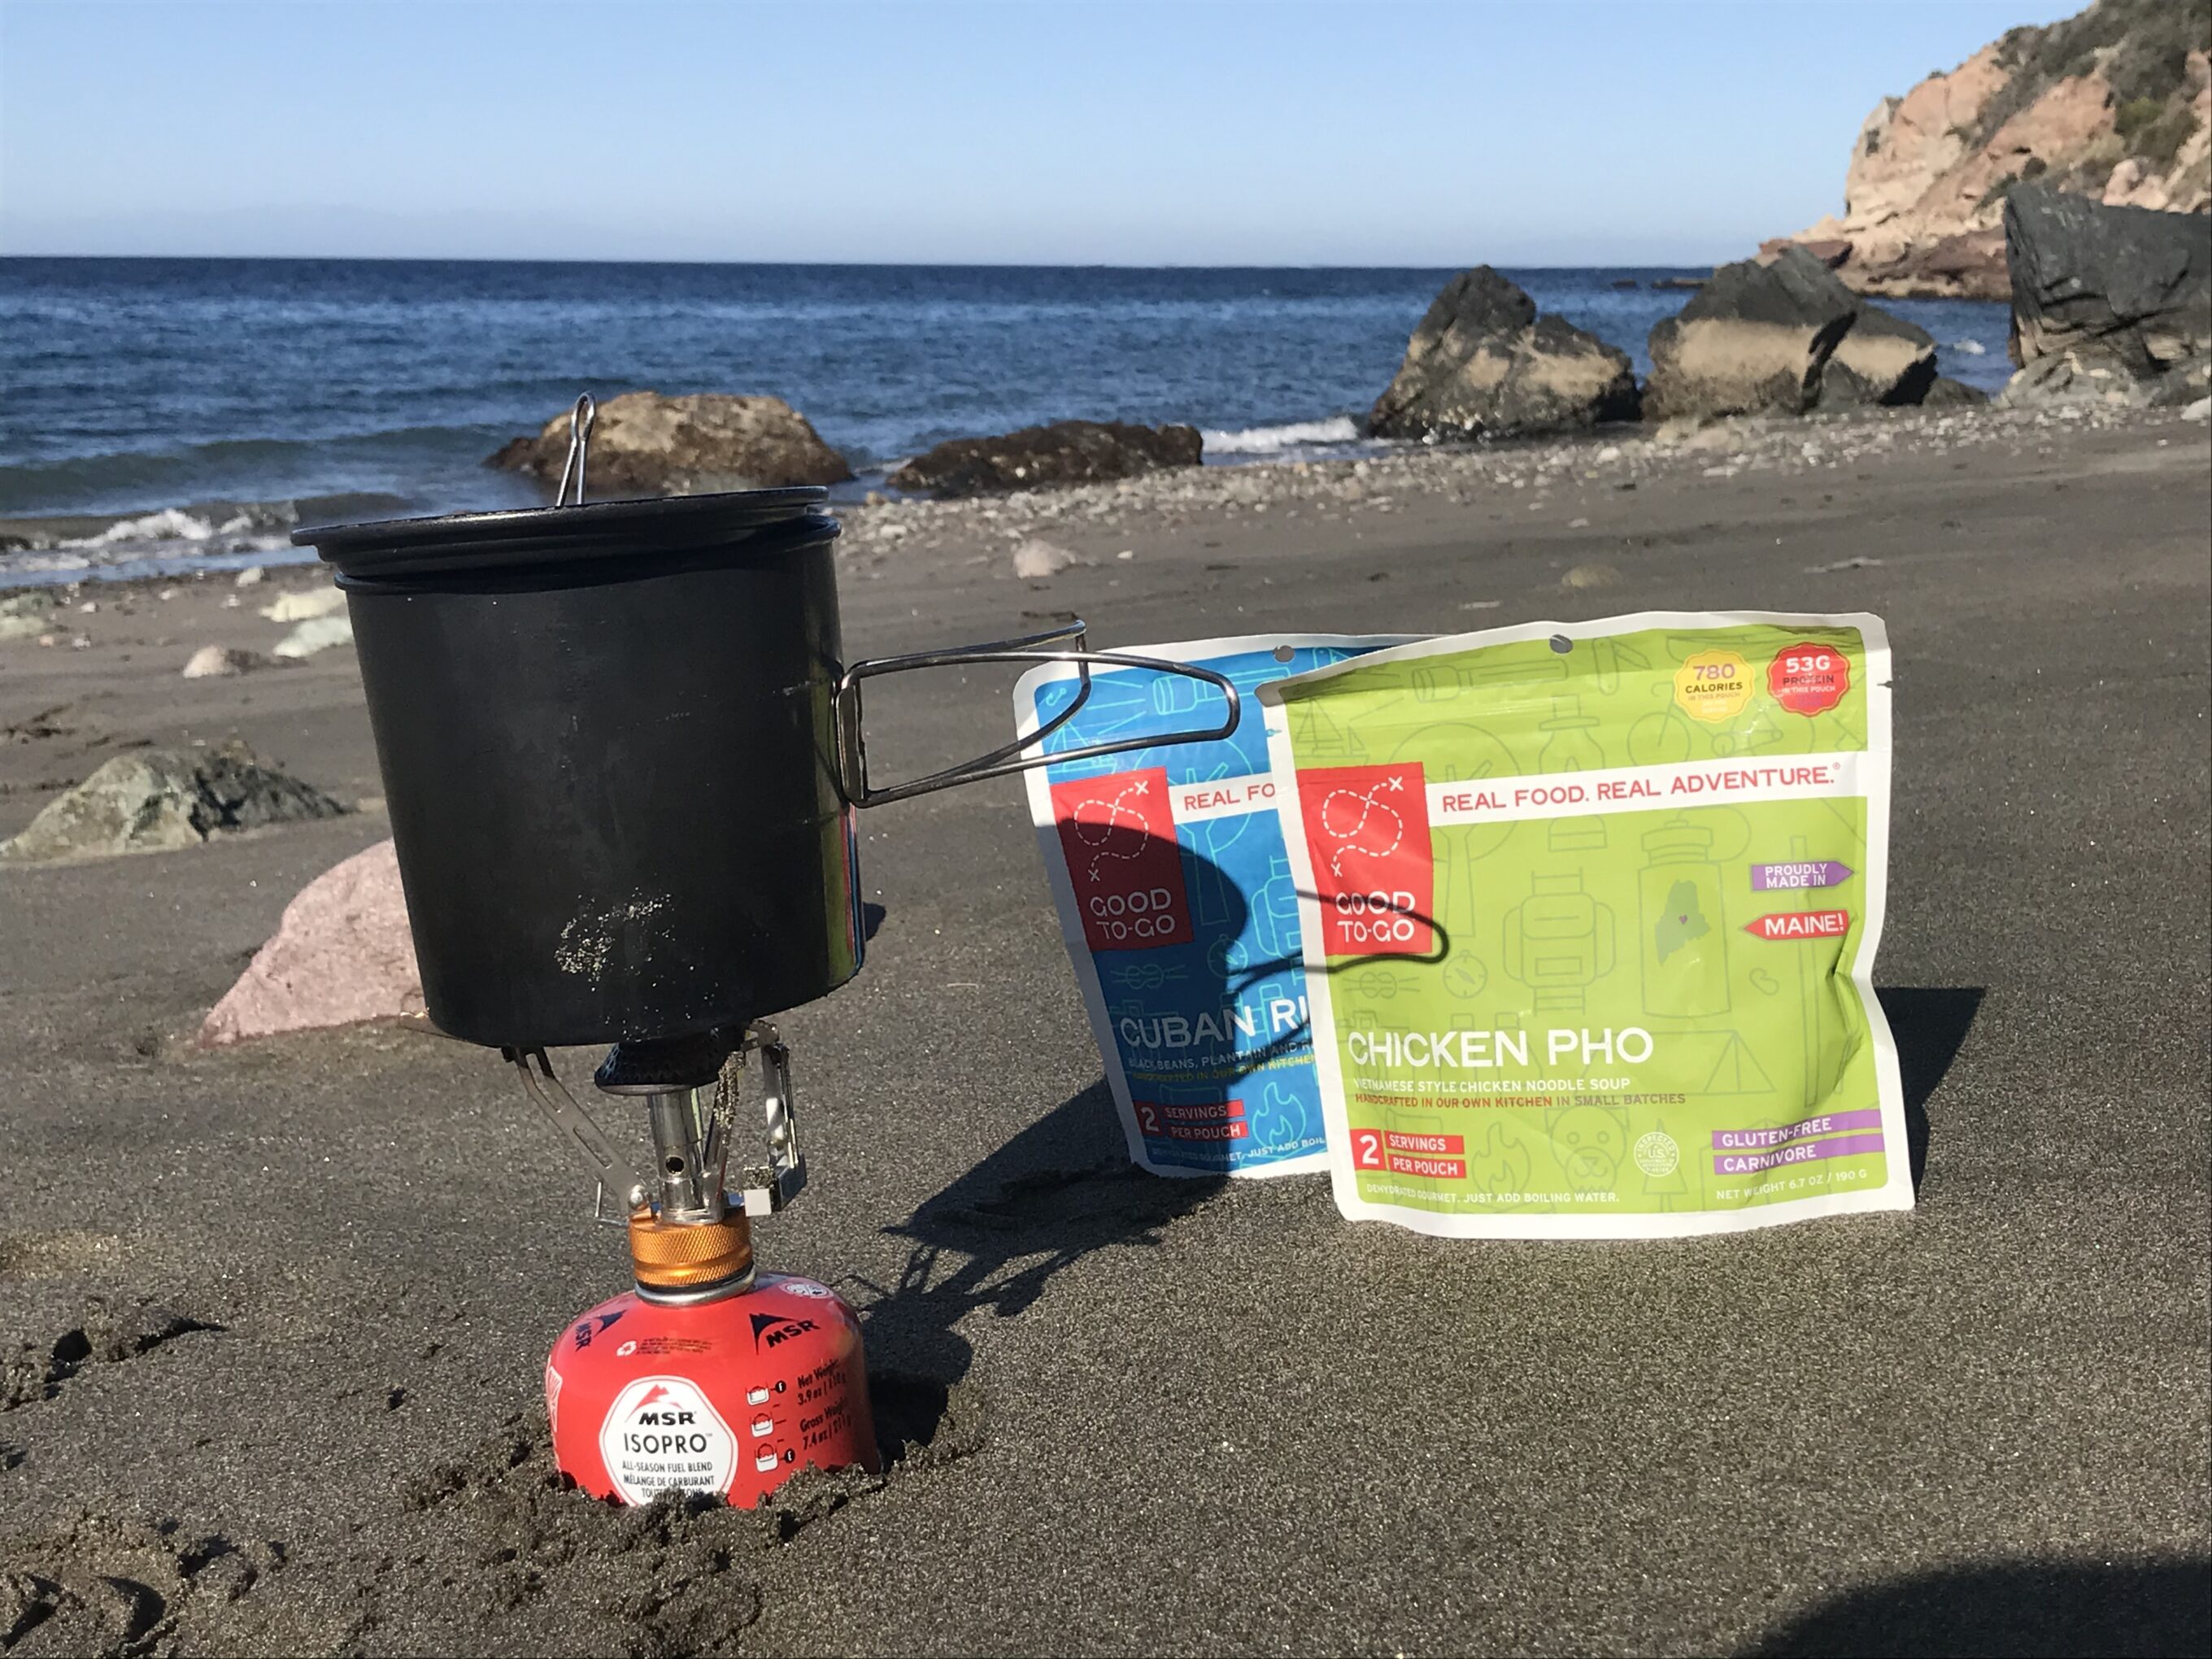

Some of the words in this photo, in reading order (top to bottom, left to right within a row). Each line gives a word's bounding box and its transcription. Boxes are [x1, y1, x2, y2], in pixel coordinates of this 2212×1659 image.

[1692, 663, 1735, 681] 780
[1786, 655, 1831, 673] 53G
[1685, 681, 1743, 694] CALORIES
[1783, 674, 1835, 686] PROTEIN
[1184, 787, 1240, 811] REAL
[1443, 794, 1507, 813] REAL
[1515, 786, 1589, 808] FOOD.
[1598, 779, 1661, 802] REAL
[1765, 863, 1827, 877] PROUDLY
[1766, 875, 1809, 888] MADE
[1814, 874, 1827, 886] IN
[1091, 887, 1172, 917] GOOD
[1336, 891, 1415, 916] GOOD
[1096, 914, 1176, 941] TO-GO
[1337, 919, 1414, 943] TO-GO
[1765, 912, 1844, 936] MAINE!
[1120, 1005, 1256, 1048] CUBAN
[1156, 1059, 1198, 1070] BEANS,
[1201, 1047, 1266, 1066] PLANTAIN
[1270, 1042, 1297, 1056] AND
[1348, 1030, 1526, 1068] CHICKEN
[1548, 1026, 1653, 1065] PHO
[1213, 1066, 1234, 1078] OUR
[1239, 1062, 1265, 1073] OWN
[1354, 1078, 1414, 1091] VIETNAMESE
[1417, 1080, 1457, 1092] STYLE
[1460, 1080, 1521, 1093] CHICKEN
[1526, 1079, 1586, 1091] NOODLE
[1590, 1078, 1631, 1091] SOUP
[1355, 1094, 1418, 1107] HANDCRAFTED
[1422, 1097, 1432, 1108] IN
[1436, 1097, 1459, 1108] OUR
[1462, 1097, 1491, 1108] OWN
[1496, 1096, 1552, 1108] KITCHEN
[1557, 1096, 1570, 1107] IN
[1574, 1095, 1619, 1107] SMALL
[1623, 1093, 1686, 1105] BATCHES
[1140, 1106, 1159, 1132] 2
[1165, 1104, 1227, 1120] SERVINGS
[1171, 1126, 1192, 1139] PER
[1194, 1124, 1241, 1139] POUCH
[1722, 1117, 1831, 1147] GLUTEN-FREE
[1248, 1146, 1274, 1158] JUST
[1277, 1142, 1299, 1152] ADD
[1360, 1134, 1379, 1165] 2
[1389, 1134, 1447, 1152] SERVINGS
[1393, 1156, 1413, 1173] PER
[1414, 1157, 1457, 1176] POUCH
[1723, 1145, 1817, 1172] CARNIVORE
[1366, 1183, 1416, 1198] DEHYDRATED
[1464, 1193, 1492, 1203] JUST
[1496, 1193, 1521, 1203] ADD
[1524, 1192, 1571, 1203] BOILING
[1574, 1192, 1620, 1203] WATER.
[1717, 1189, 1740, 1200] NET
[1744, 1181, 1785, 1198] WEIGHT
[1788, 1178, 1805, 1190] 6.7
[1809, 1175, 1823, 1187] OZ
[1835, 1170, 1855, 1182] 190
[1858, 1169, 1867, 1178] G
[575, 1322, 592, 1352] MSR
[765, 1320, 821, 1348] MSR
[798, 1374, 812, 1388] Net
[798, 1389, 812, 1405] 3.9
[638, 1412, 696, 1426] MSR
[800, 1414, 823, 1432] Gross
[803, 1431, 816, 1449] 7.4
[622, 1461, 665, 1473] ALL-SEASON
[668, 1462, 686, 1473] FUEL
[688, 1461, 712, 1472] BLEND
[624, 1472, 655, 1486] MÉLANGE
[657, 1477, 666, 1487] DE
[668, 1475, 714, 1487] CARBURANT
[642, 1487, 663, 1497] TOUT
